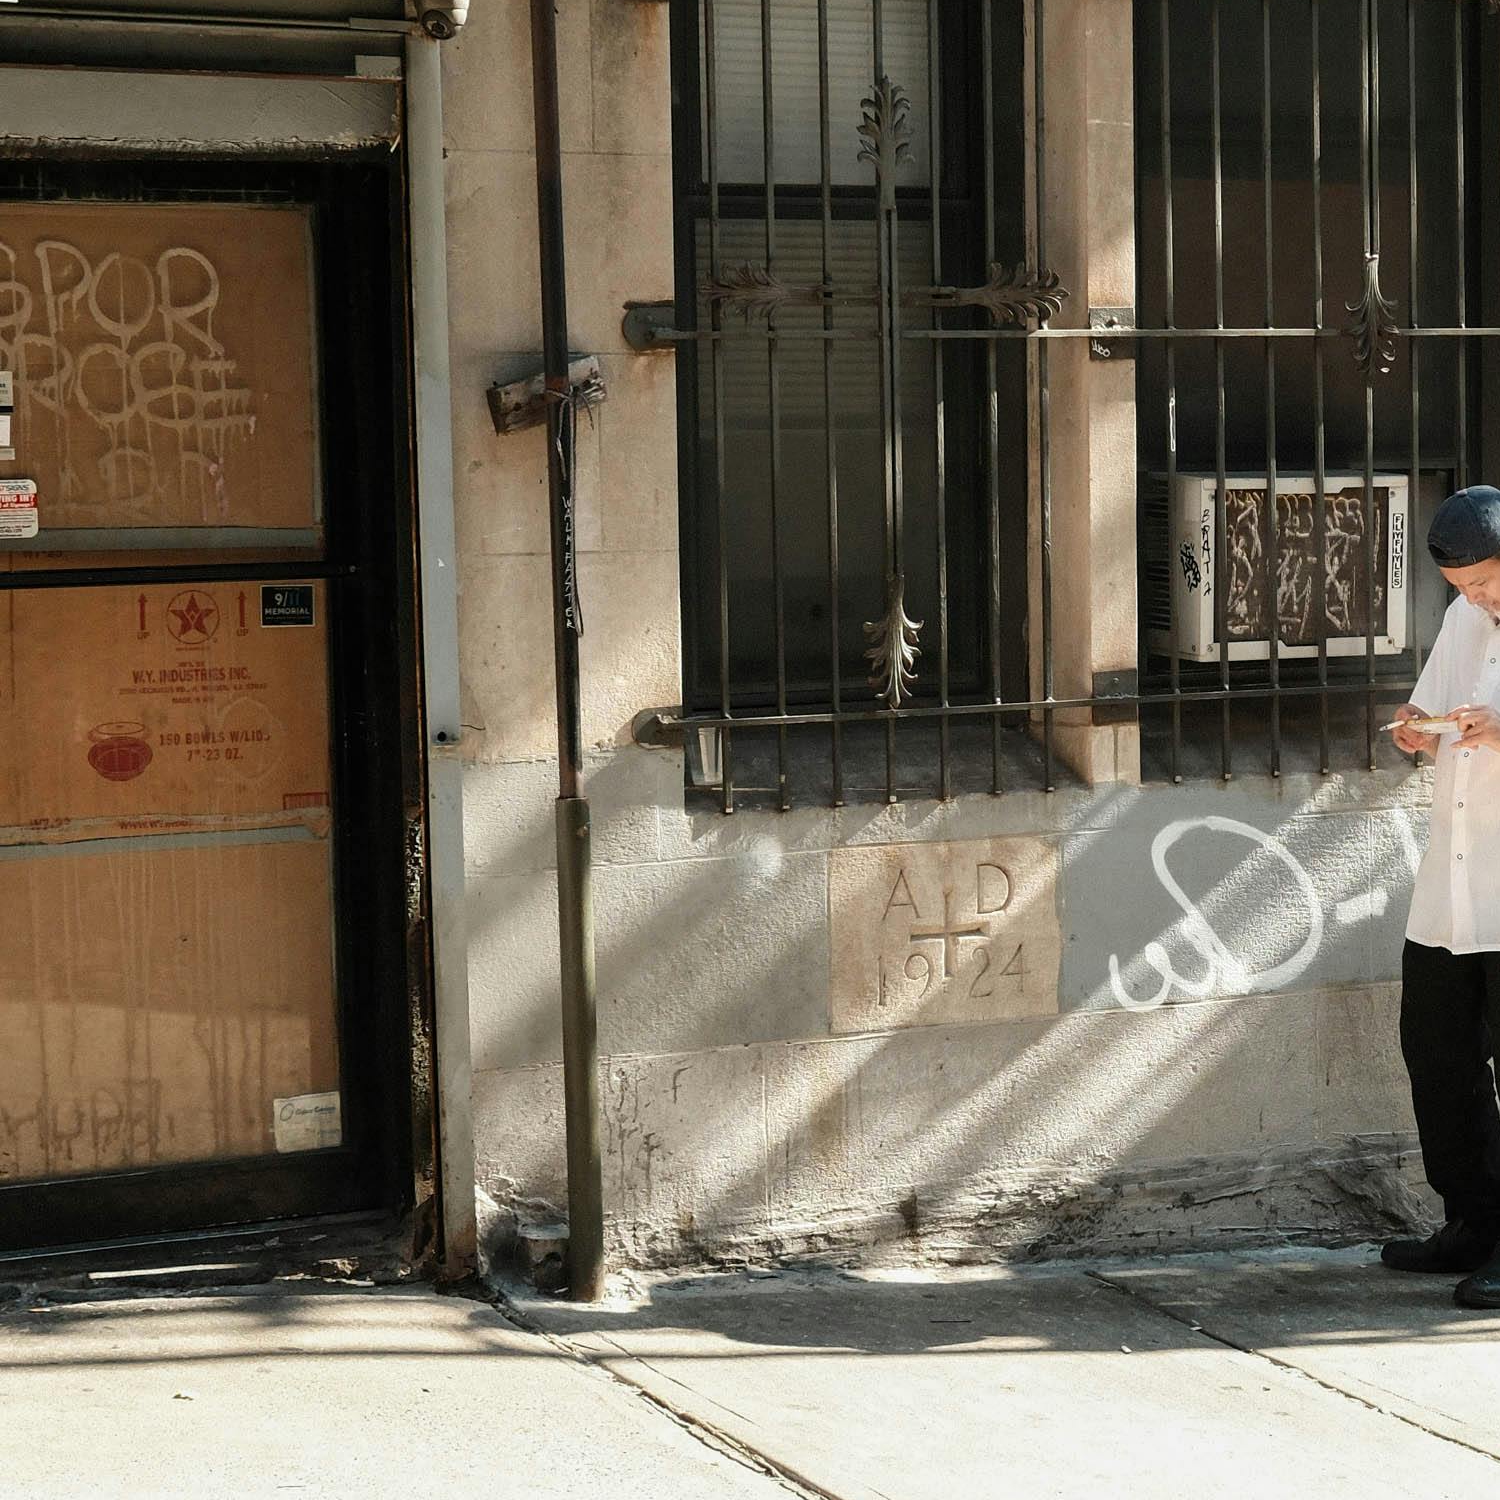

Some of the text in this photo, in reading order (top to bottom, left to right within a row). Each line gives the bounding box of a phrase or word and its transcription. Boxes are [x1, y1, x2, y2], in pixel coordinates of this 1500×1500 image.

[264, 607, 310, 616] MEMORIAL
[159, 668, 225, 682] INDUSTRIES
[230, 667, 251, 681] INC.
[185, 731, 225, 745] BOWLS
[882, 862, 1014, 921] A D
